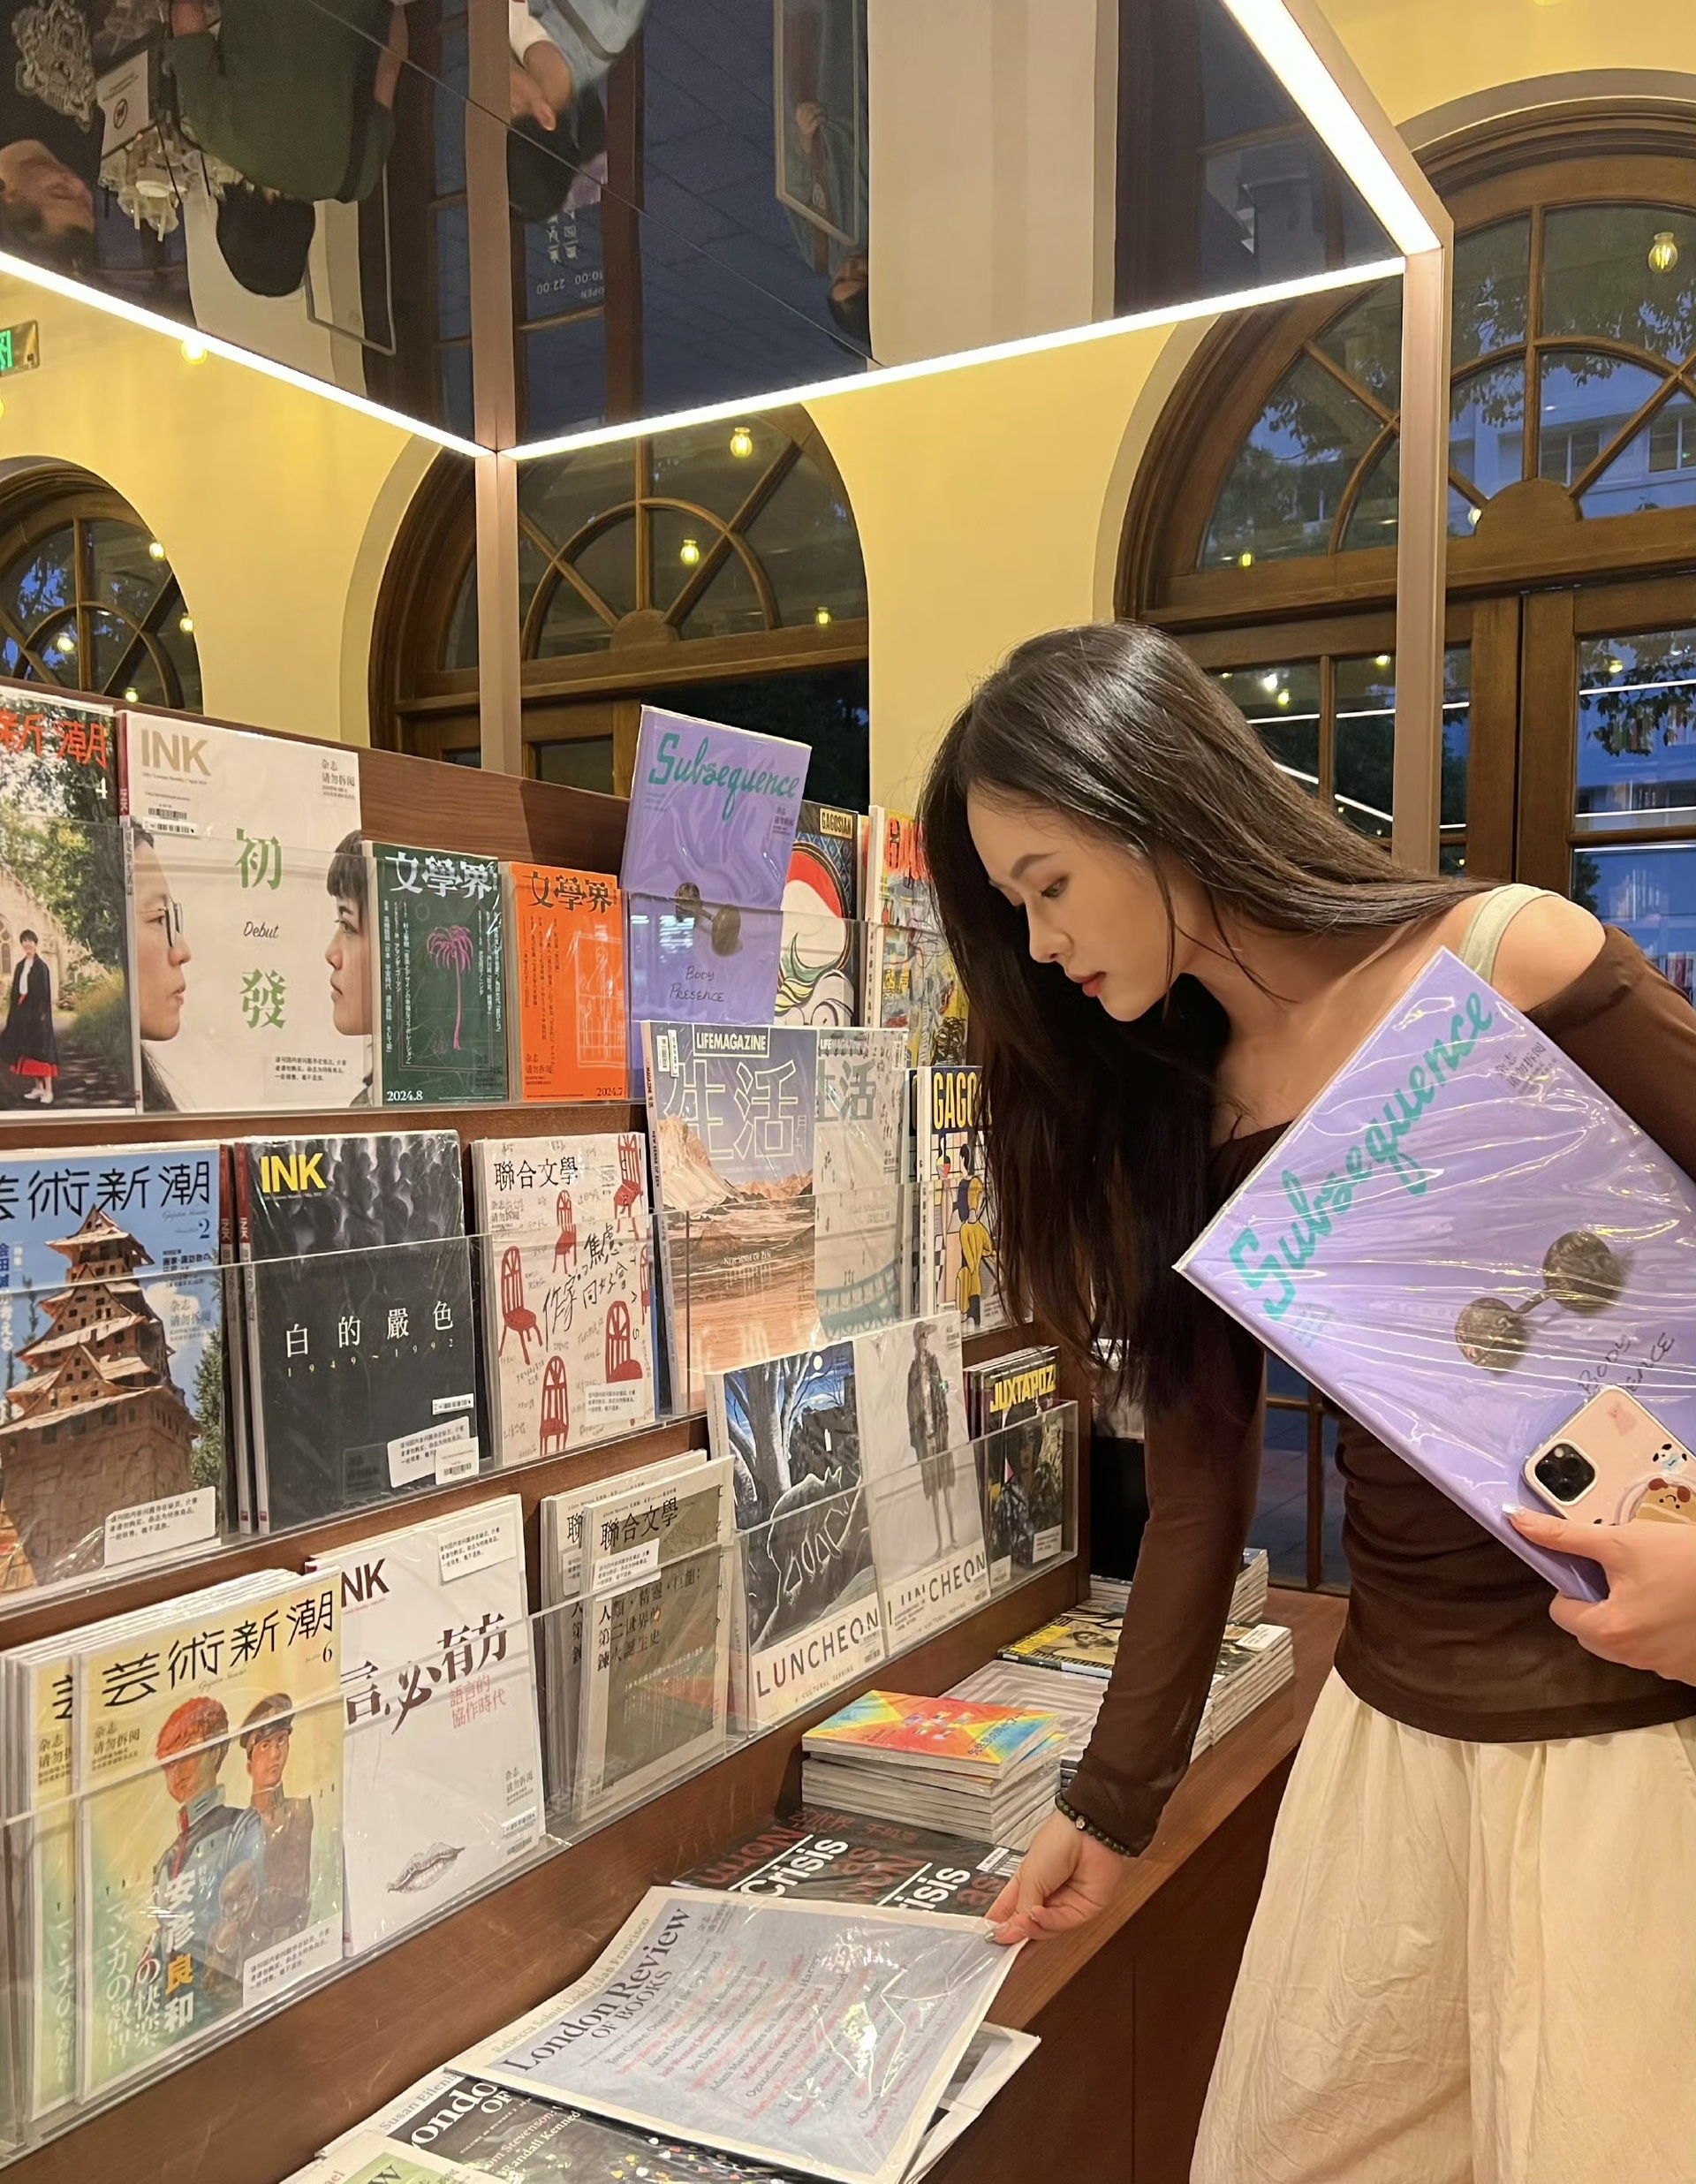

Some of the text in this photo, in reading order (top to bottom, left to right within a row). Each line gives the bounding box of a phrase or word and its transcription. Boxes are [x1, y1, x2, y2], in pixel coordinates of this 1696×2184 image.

[141, 729, 211, 776] INK
[95, 777, 108, 800] 4
[647, 732, 801, 823] Subsequence
[821, 811, 852, 835] GAGOSIAN
[235, 828, 283, 891] 初
[384, 852, 494, 900] 文學界
[522, 870, 613, 914] 文學界
[243, 921, 280, 938] Debut
[239, 968, 288, 1028] 發
[669, 984, 726, 1004] PRESENCE
[696, 1032, 767, 1051] LIFEMAGAZINE
[386, 1090, 423, 1102] 2024.8
[596, 1087, 624, 1096] 2024.7
[663, 1058, 797, 1161] 生活
[260, 1152, 327, 1194] INK
[494, 1156, 579, 1192] 聯合文學
[1229, 991, 1494, 1323] Subsequence
[198, 1217, 210, 1240] 2
[1626, 1330, 1677, 1394] ENCE
[989, 1363, 1056, 1413] JUXTAPOZ
[600, 1497, 678, 1552] 聯合文學
[341, 1558, 390, 1608] NK
[102, 1590, 333, 1707] 芸術新潮
[322, 1640, 333, 1664] 6
[756, 1608, 879, 1698] LUNCHEON
[450, 1674, 491, 1706] 語言的
[451, 1688, 507, 1730] 協作時代
[740, 1839, 849, 1898] Crisis
[898, 1867, 972, 1912] isis
[957, 1875, 1007, 1907] as
[163, 1869, 197, 2034] 安彦良和
[491, 2025, 537, 2052] Rebecca
[606, 1917, 653, 1964] Francisco
[498, 1907, 696, 2071] London Review
[588, 1969, 674, 2039] OF BOOKS
[646, 2051, 670, 2067] Anna
[707, 2070, 735, 2091] Adam
[378, 2073, 458, 2131] Susan Eilenb
[411, 2082, 498, 2150] ondo
[480, 2089, 513, 2114] OF
[485, 2108, 559, 2173] om Stevenson:
[500, 2111, 582, 2180] Randall Kenned
